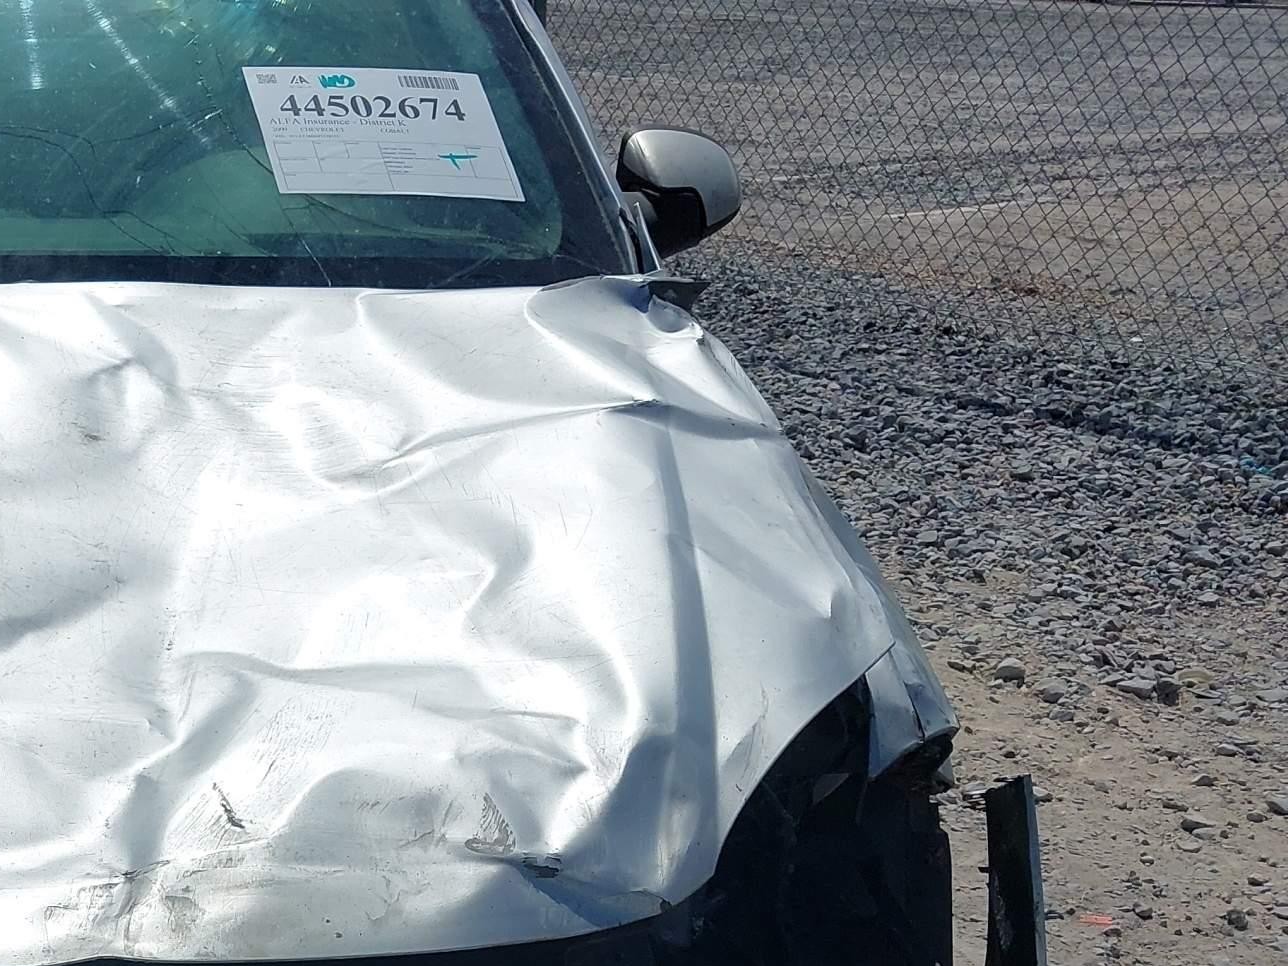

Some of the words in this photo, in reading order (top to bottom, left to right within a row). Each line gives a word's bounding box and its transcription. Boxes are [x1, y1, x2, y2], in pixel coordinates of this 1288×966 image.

[280, 94, 466, 121] 44502674
[270, 118, 302, 126] ALFA
[304, 118, 351, 126] Insurance
[359, 118, 397, 127] District
[398, 119, 408, 127] K
